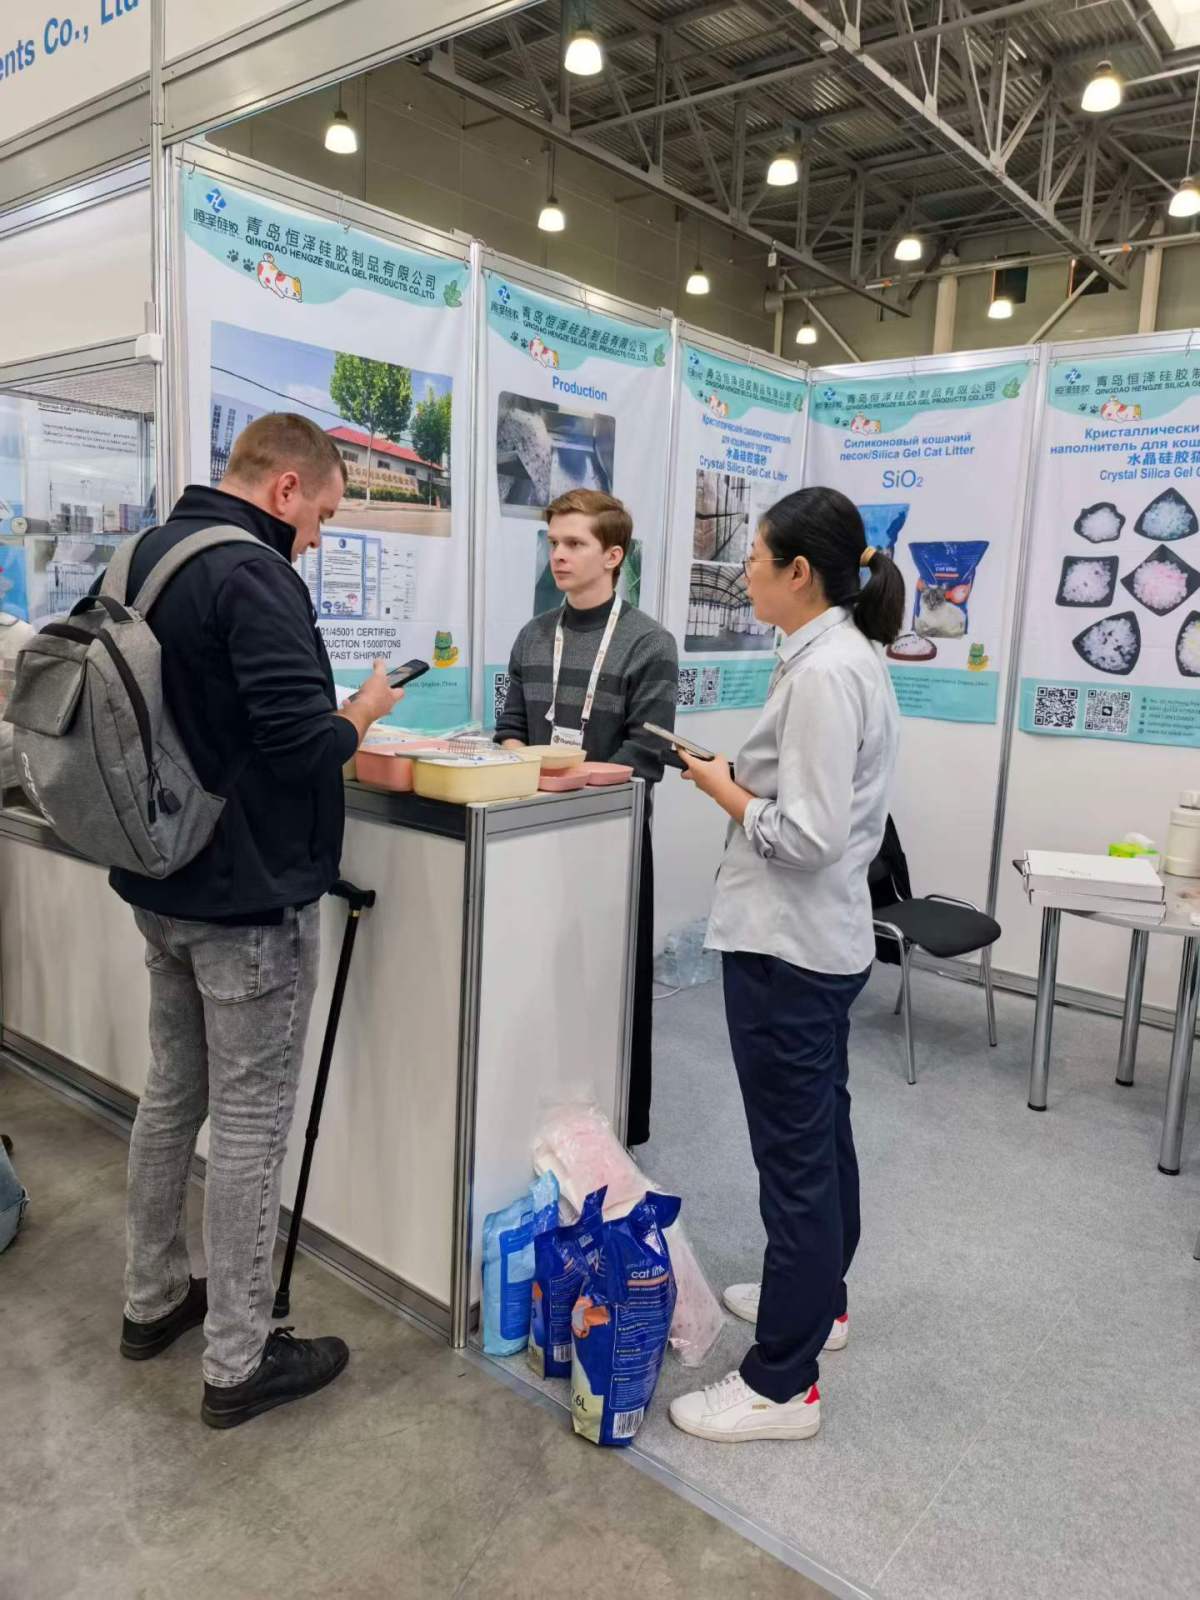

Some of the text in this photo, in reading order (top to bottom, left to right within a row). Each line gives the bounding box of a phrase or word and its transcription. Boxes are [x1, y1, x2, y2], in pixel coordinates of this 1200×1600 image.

[44, 17, 89, 54] Co.,
[246, 216, 436, 291] 青岛恒泽硅胶制品有限公司
[245, 235, 288, 255] QINGDAO
[289, 248, 323, 266] HENGZE
[324, 259, 350, 274] SILICA
[351, 267, 367, 280] GEL
[368, 272, 408, 291] PRODUCTS
[552, 375, 608, 401] Production
[1094, 387, 1130, 396] QINGDAO
[1131, 383, 1163, 393] HENGZE
[1165, 380, 1190, 389] SILICA
[843, 432, 972, 449] Силиконовый кошачий
[1050, 442, 1138, 455] наполнитель
[1141, 439, 1169, 452] для
[902, 447, 922, 459] Gel
[923, 446, 943, 458] Cat
[945, 445, 977, 457] Litter
[699, 454, 726, 470] Crystal
[726, 460, 746, 474] Silica
[746, 465, 759, 477] Gel
[759, 467, 772, 480] Cat
[1099, 468, 1138, 483] Crystal
[1140, 467, 1171, 480] Silica
[1173, 465, 1193, 478] Gel
[356, 627, 397, 637] CERTIFIED
[362, 639, 401, 648] 15000TONS
[330, 650, 392, 660] FAST SHIPMENT
[631, 1269, 650, 1279] cat
